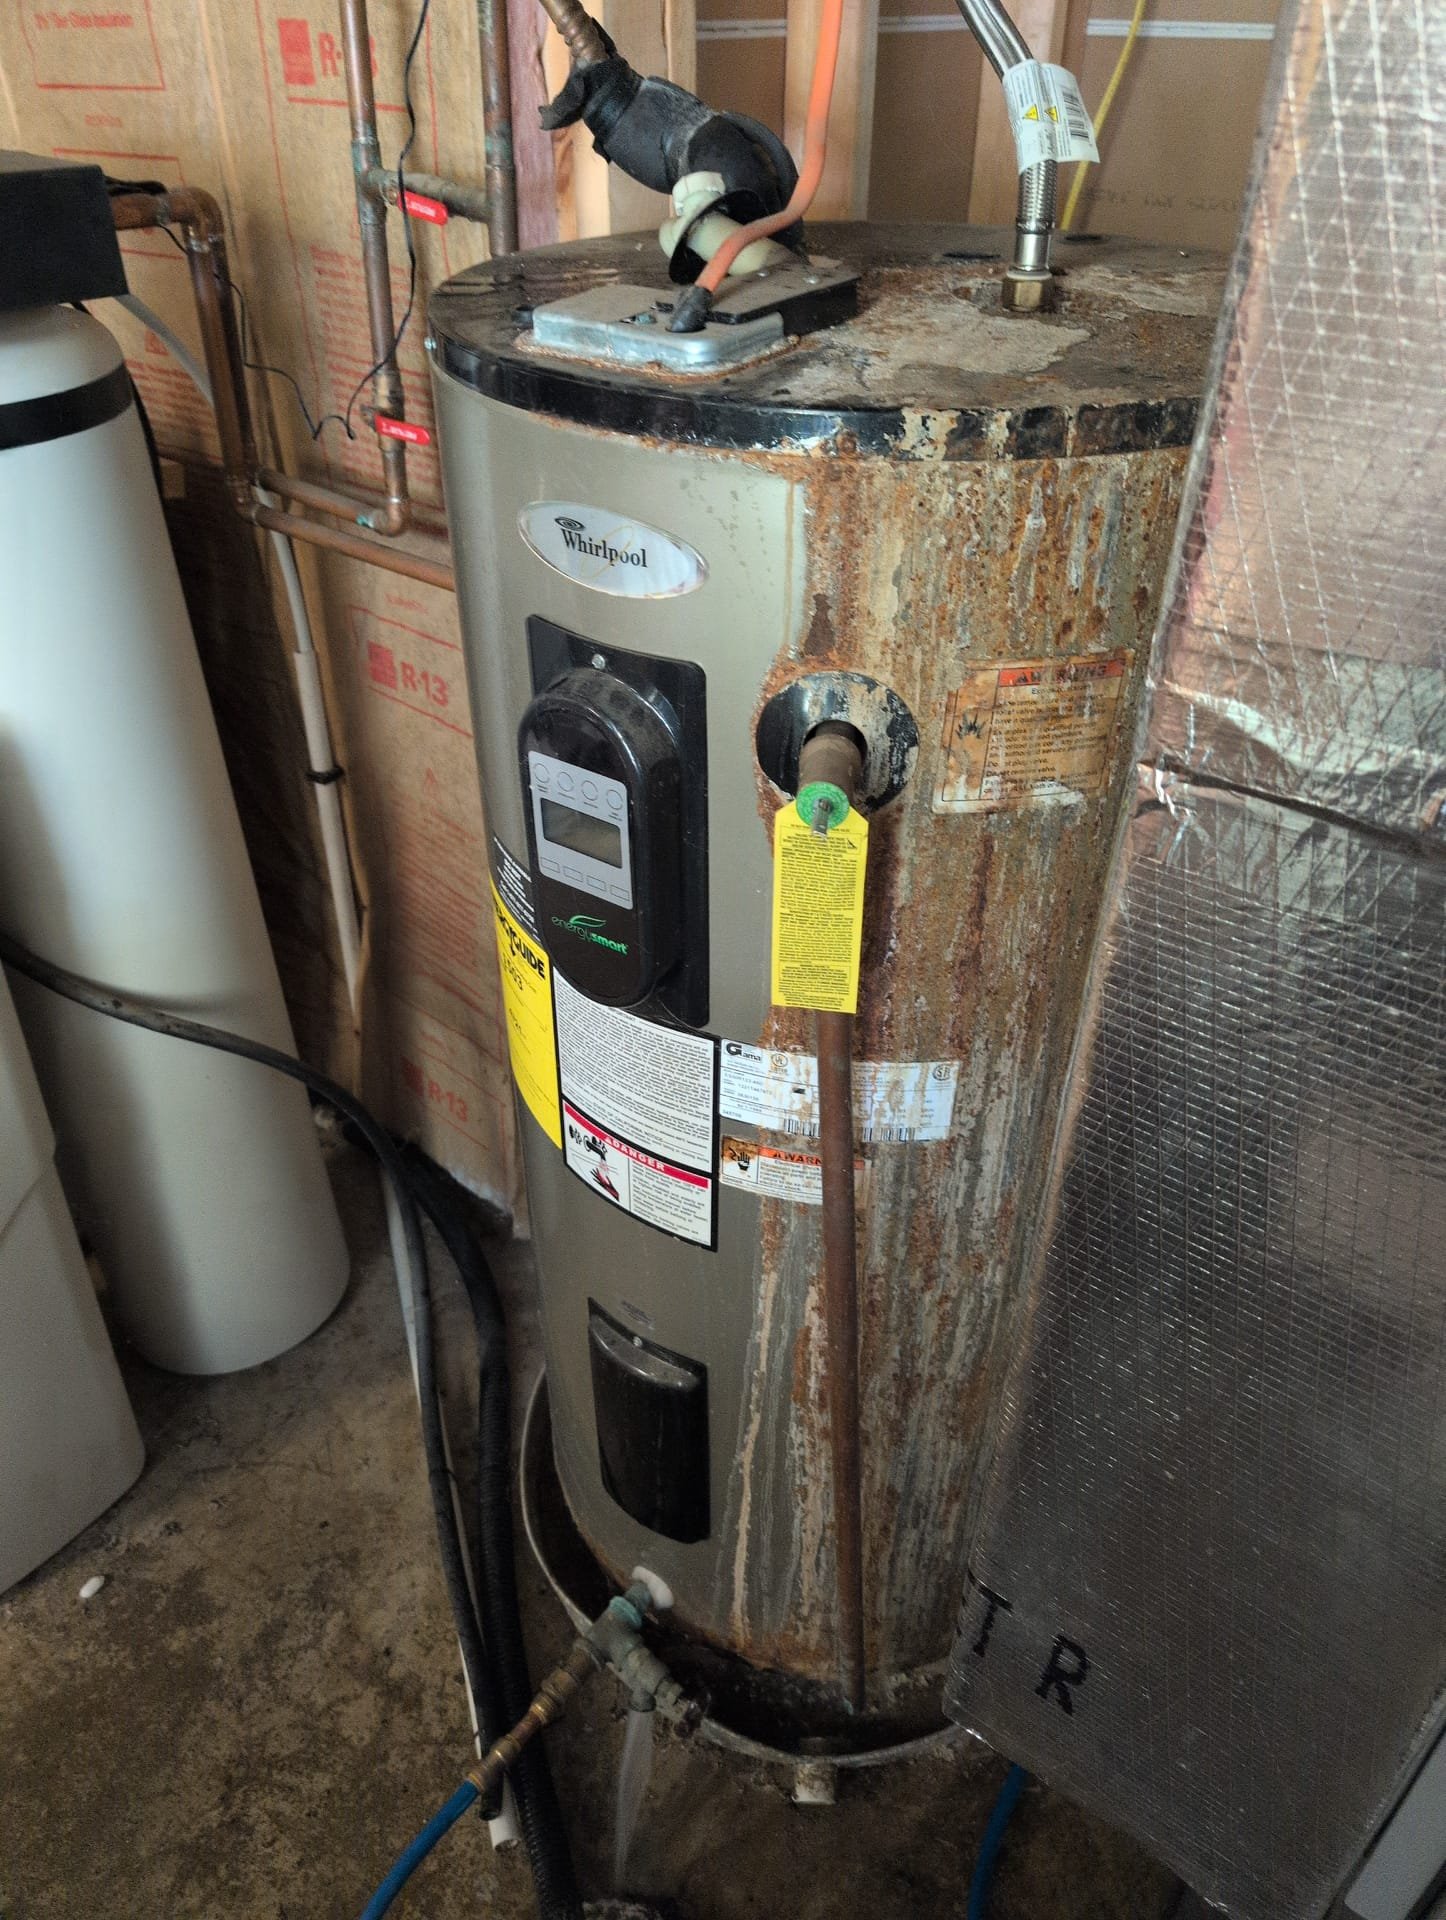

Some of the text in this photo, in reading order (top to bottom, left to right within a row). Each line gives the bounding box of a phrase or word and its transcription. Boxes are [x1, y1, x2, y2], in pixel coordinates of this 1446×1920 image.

[561, 528, 648, 567] Whirlpool
[551, 916, 628, 955] energysmart
[612, 1138, 665, 1171] DANGER
[1034, 1634, 1091, 1716] R
